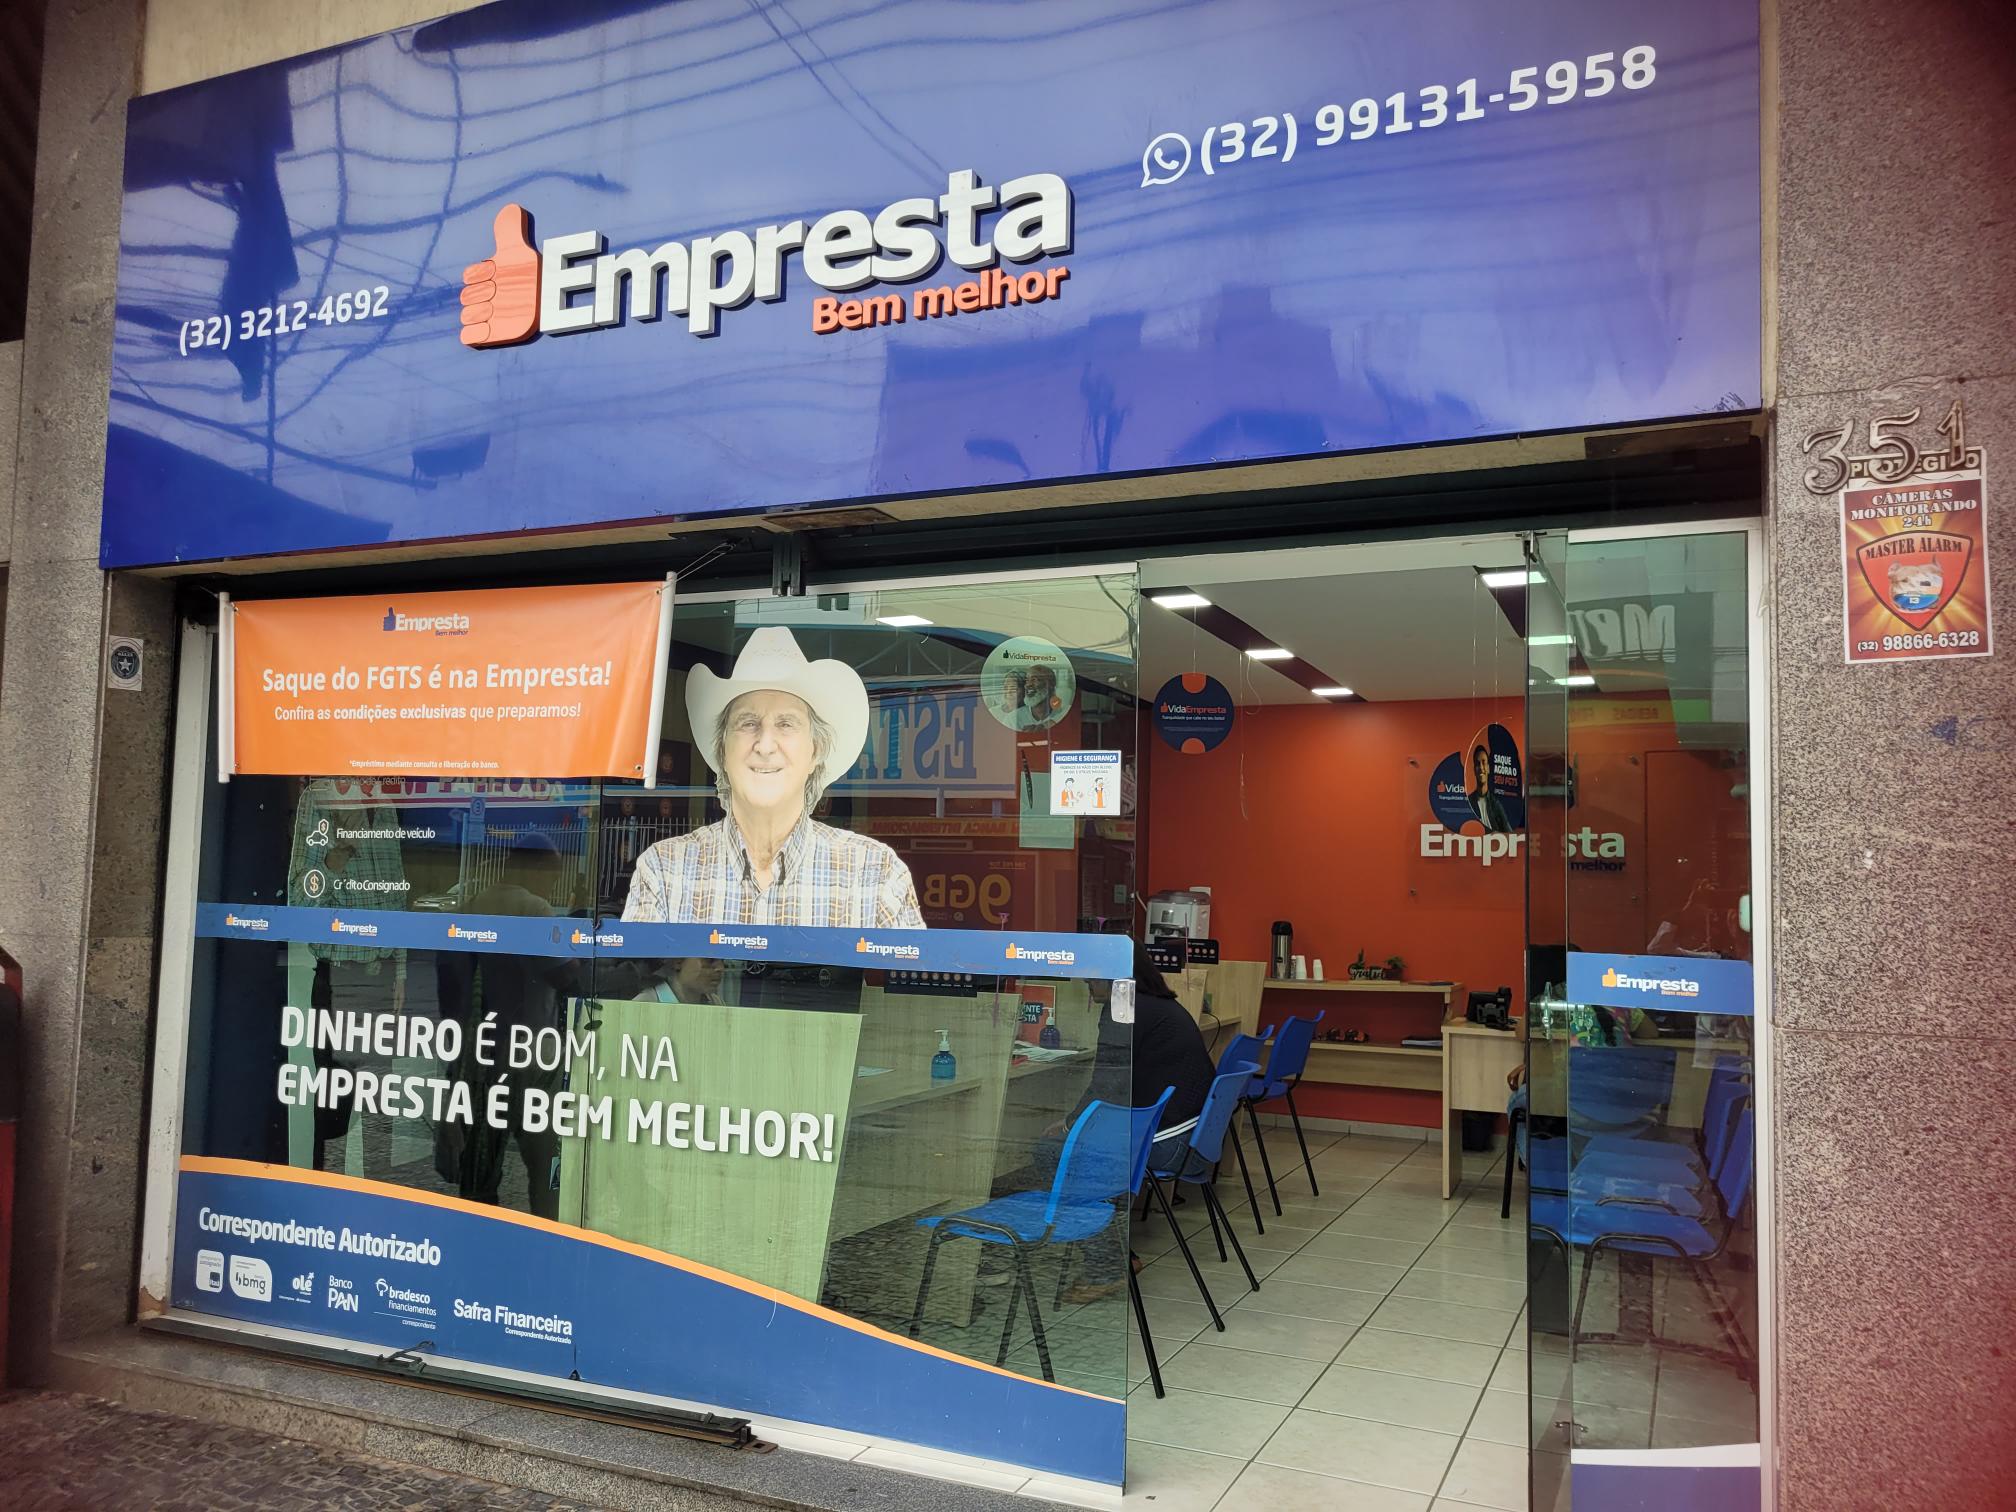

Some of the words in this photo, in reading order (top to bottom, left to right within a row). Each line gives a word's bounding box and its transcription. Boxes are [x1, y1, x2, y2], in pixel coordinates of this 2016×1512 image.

[1200, 113, 1298, 175] (32)
[1315, 45, 1657, 147] 99131-5958
[540, 169, 1073, 334] Empresta
[812, 294, 906, 334] Bem
[913, 266, 1070, 320] melhor
[180, 315, 232, 357] (32)
[239, 285, 389, 340] 3212-4692
[1872, 488, 1953, 506] CÂMERAS
[1850, 499, 1977, 521] MONITORANDO
[1903, 513, 1932, 528] 24h
[1865, 538, 1915, 559] MASTER
[1919, 537, 1962, 552] ALARM
[395, 613, 470, 632] Empresta
[1857, 641, 1879, 652] (32)
[1883, 630, 1980, 651] 98866-6328
[262, 668, 326, 698] Saque
[331, 666, 360, 691] do
[367, 665, 423, 690] FGTS
[428, 663, 442, 689] é
[449, 669, 478, 688] na
[487, 661, 612, 695] Empresta!
[275, 705, 314, 721] Confira
[317, 709, 331, 720] as
[334, 704, 397, 724] condições
[400, 704, 466, 719] exclusivas
[470, 707, 494, 721] que
[497, 702, 582, 721] preparamos!
[1168, 705, 1226, 714] VidaEmpresta
[1083, 755, 1117, 763] SEGURANÇA
[1494, 754, 1511, 766] SAQUE
[1494, 766, 1512, 776] AGORA
[1513, 768, 1517, 776] O
[336, 828, 394, 839] Financiamento
[395, 827, 406, 839] de
[407, 827, 436, 839] veículo
[333, 879, 362, 890] Crdito
[363, 880, 411, 893] Consignado
[233, 916, 269, 929] Empresta
[339, 922, 378, 934] Empresta
[456, 927, 498, 941] Empresta
[718, 933, 768, 947] Empresta
[865, 941, 920, 956] Empresta
[1016, 947, 1075, 962] Empresta
[1616, 973, 1699, 992] Empresta
[280, 1006, 463, 1062] DINHEIRO
[475, 1011, 496, 1066] É
[509, 1024, 606, 1081] BOM,
[620, 1033, 679, 1082] NA
[277, 1063, 474, 1127] EMPRESTA
[487, 1074, 509, 1129] É
[522, 1087, 612, 1141] BEM
[627, 1098, 834, 1163] MELHOR!
[199, 1206, 335, 1251] Correspondente
[338, 1228, 441, 1266] Autorizado
[242, 1273, 266, 1295] bmg
[329, 1275, 353, 1290] Banco
[328, 1288, 359, 1313] PAN
[389, 1286, 431, 1304] bradesco
[388, 1299, 437, 1317] financiamentos
[453, 1298, 492, 1322] Safra
[494, 1305, 573, 1336] Financeira
[504, 1327, 544, 1340] Correspondente
[544, 1333, 572, 1345] Autorizado
